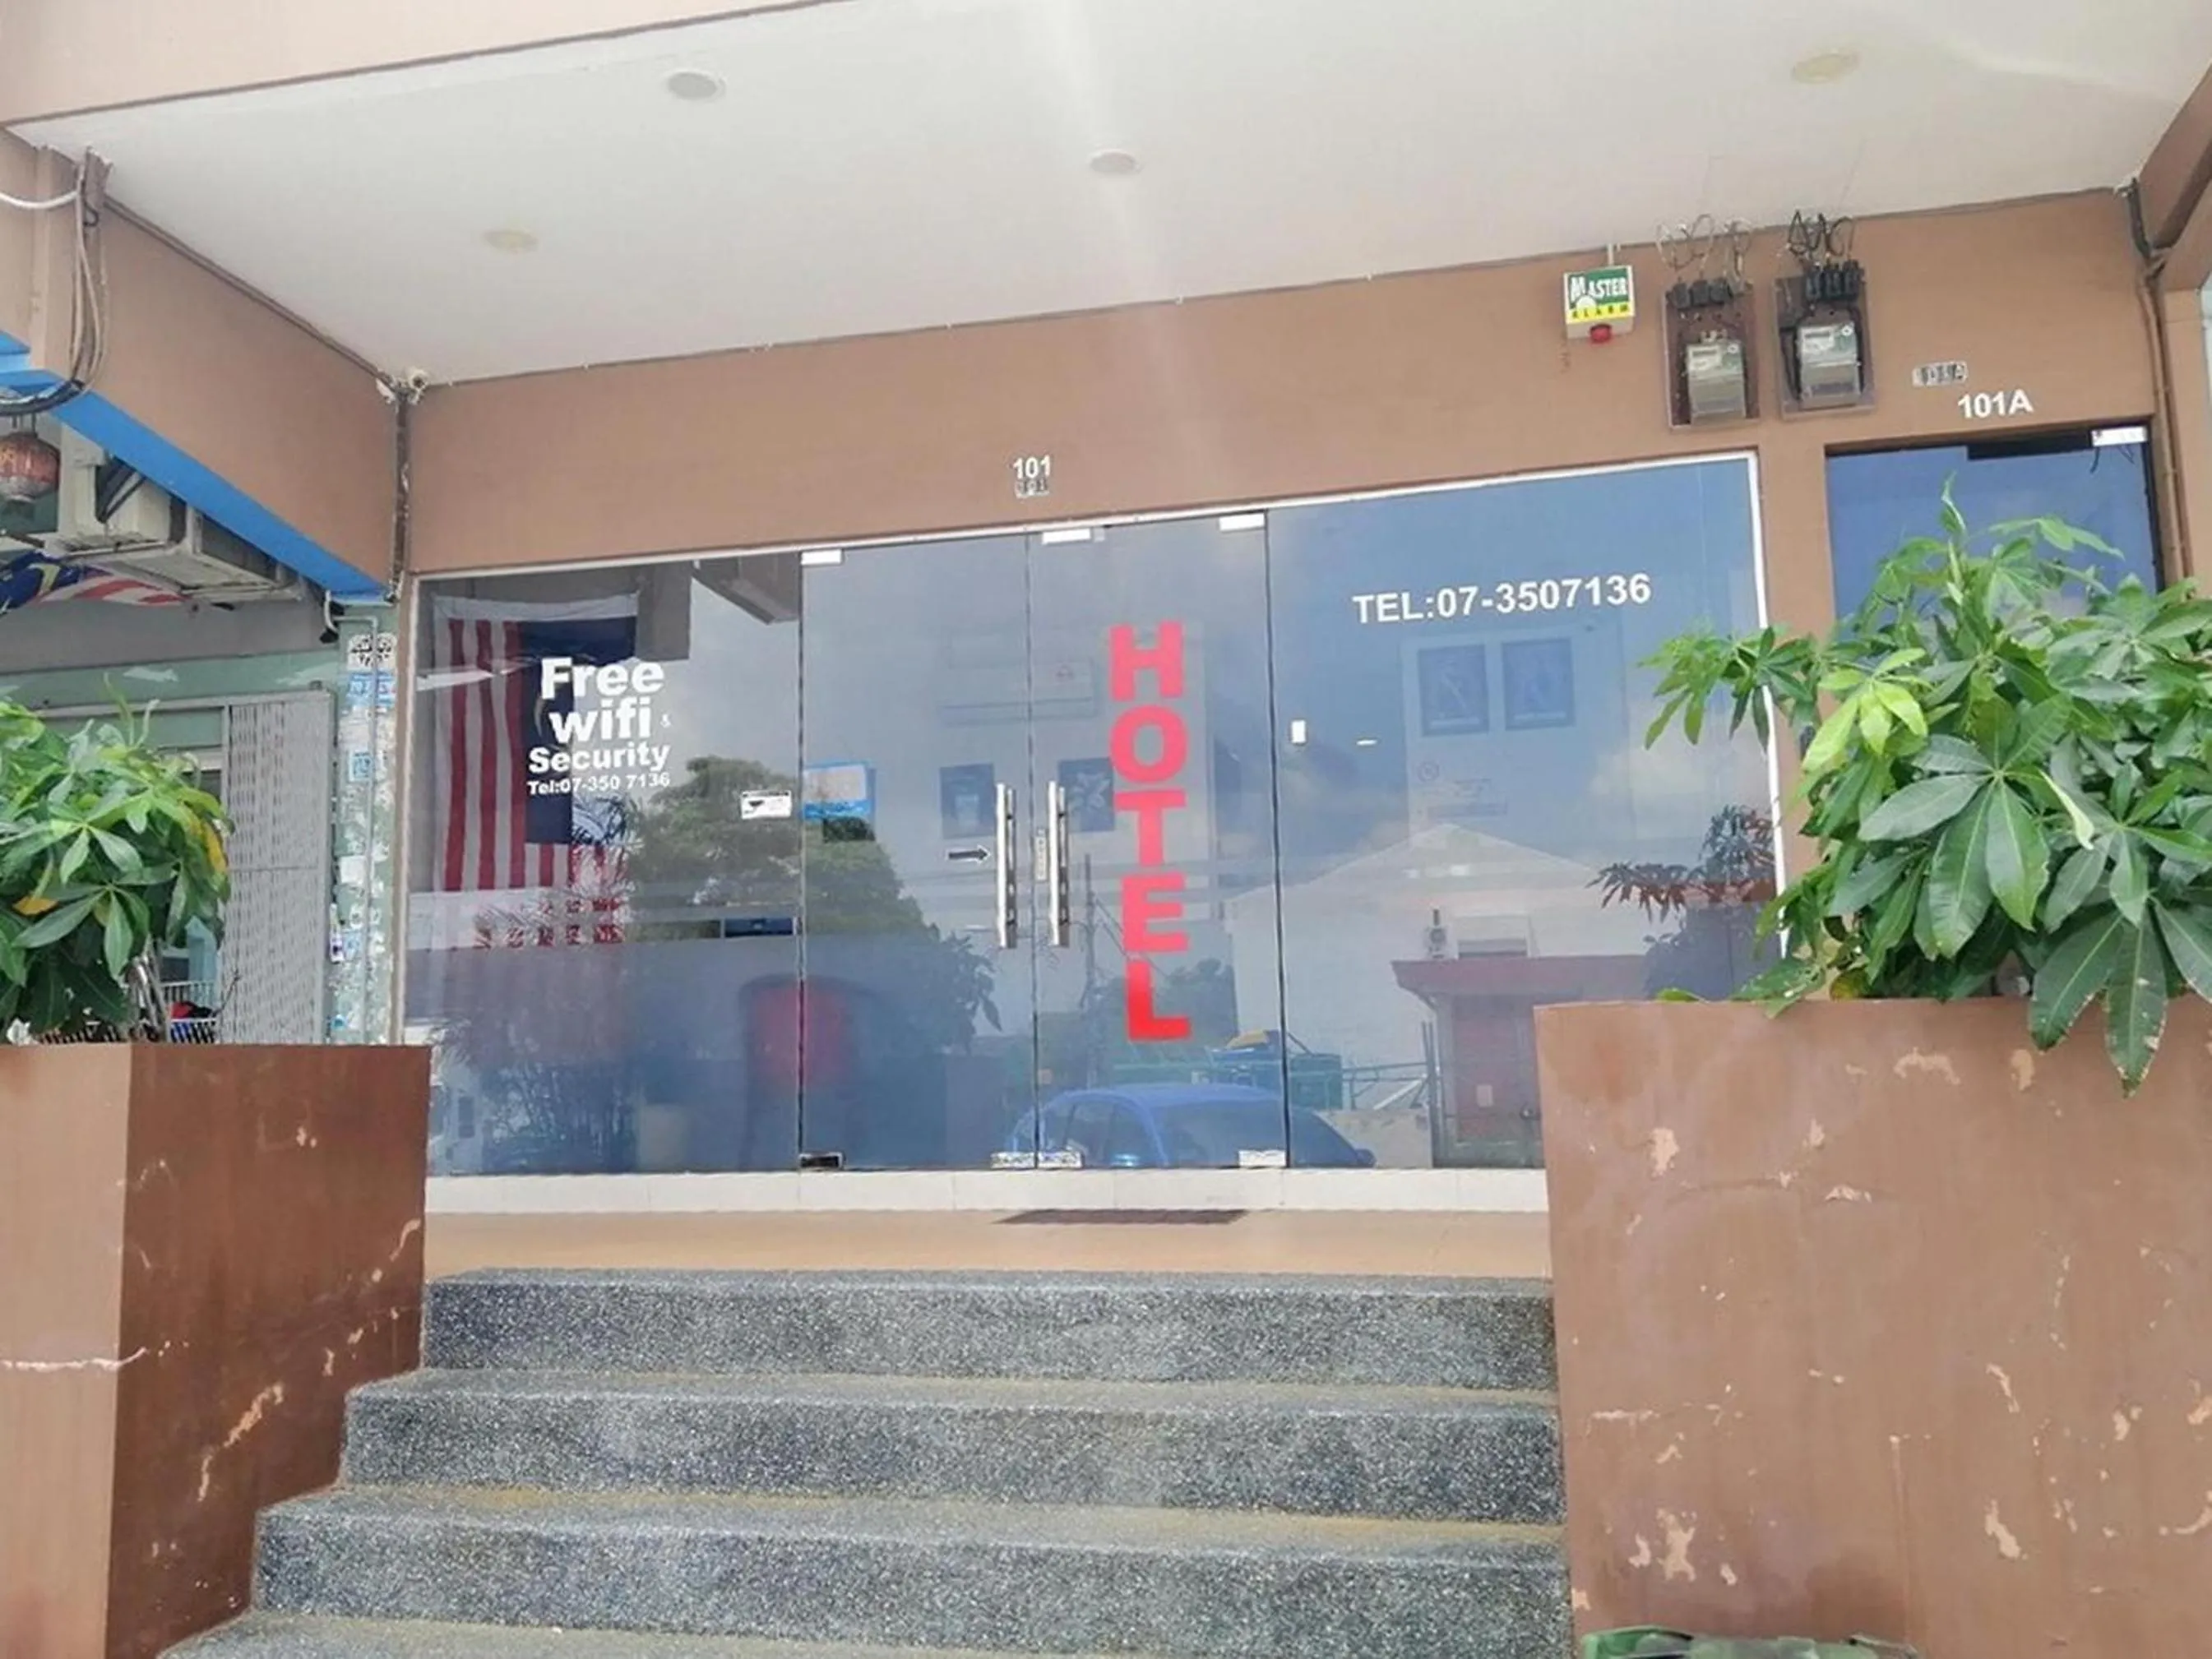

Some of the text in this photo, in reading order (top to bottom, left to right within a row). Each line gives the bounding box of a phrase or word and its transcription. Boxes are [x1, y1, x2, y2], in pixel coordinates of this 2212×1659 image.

[1571, 276, 1627, 303] MASTER
[1957, 388, 2034, 418] 101A
[1013, 454, 1051, 479] 101
[1353, 573, 1651, 624] TEL:07-3507136
[541, 657, 664, 700] Free
[548, 696, 650, 743] wifi
[529, 742, 671, 774] Security
[527, 772, 671, 795] Tel:07-350 7136
[1109, 620, 1191, 1042] HOTEL
